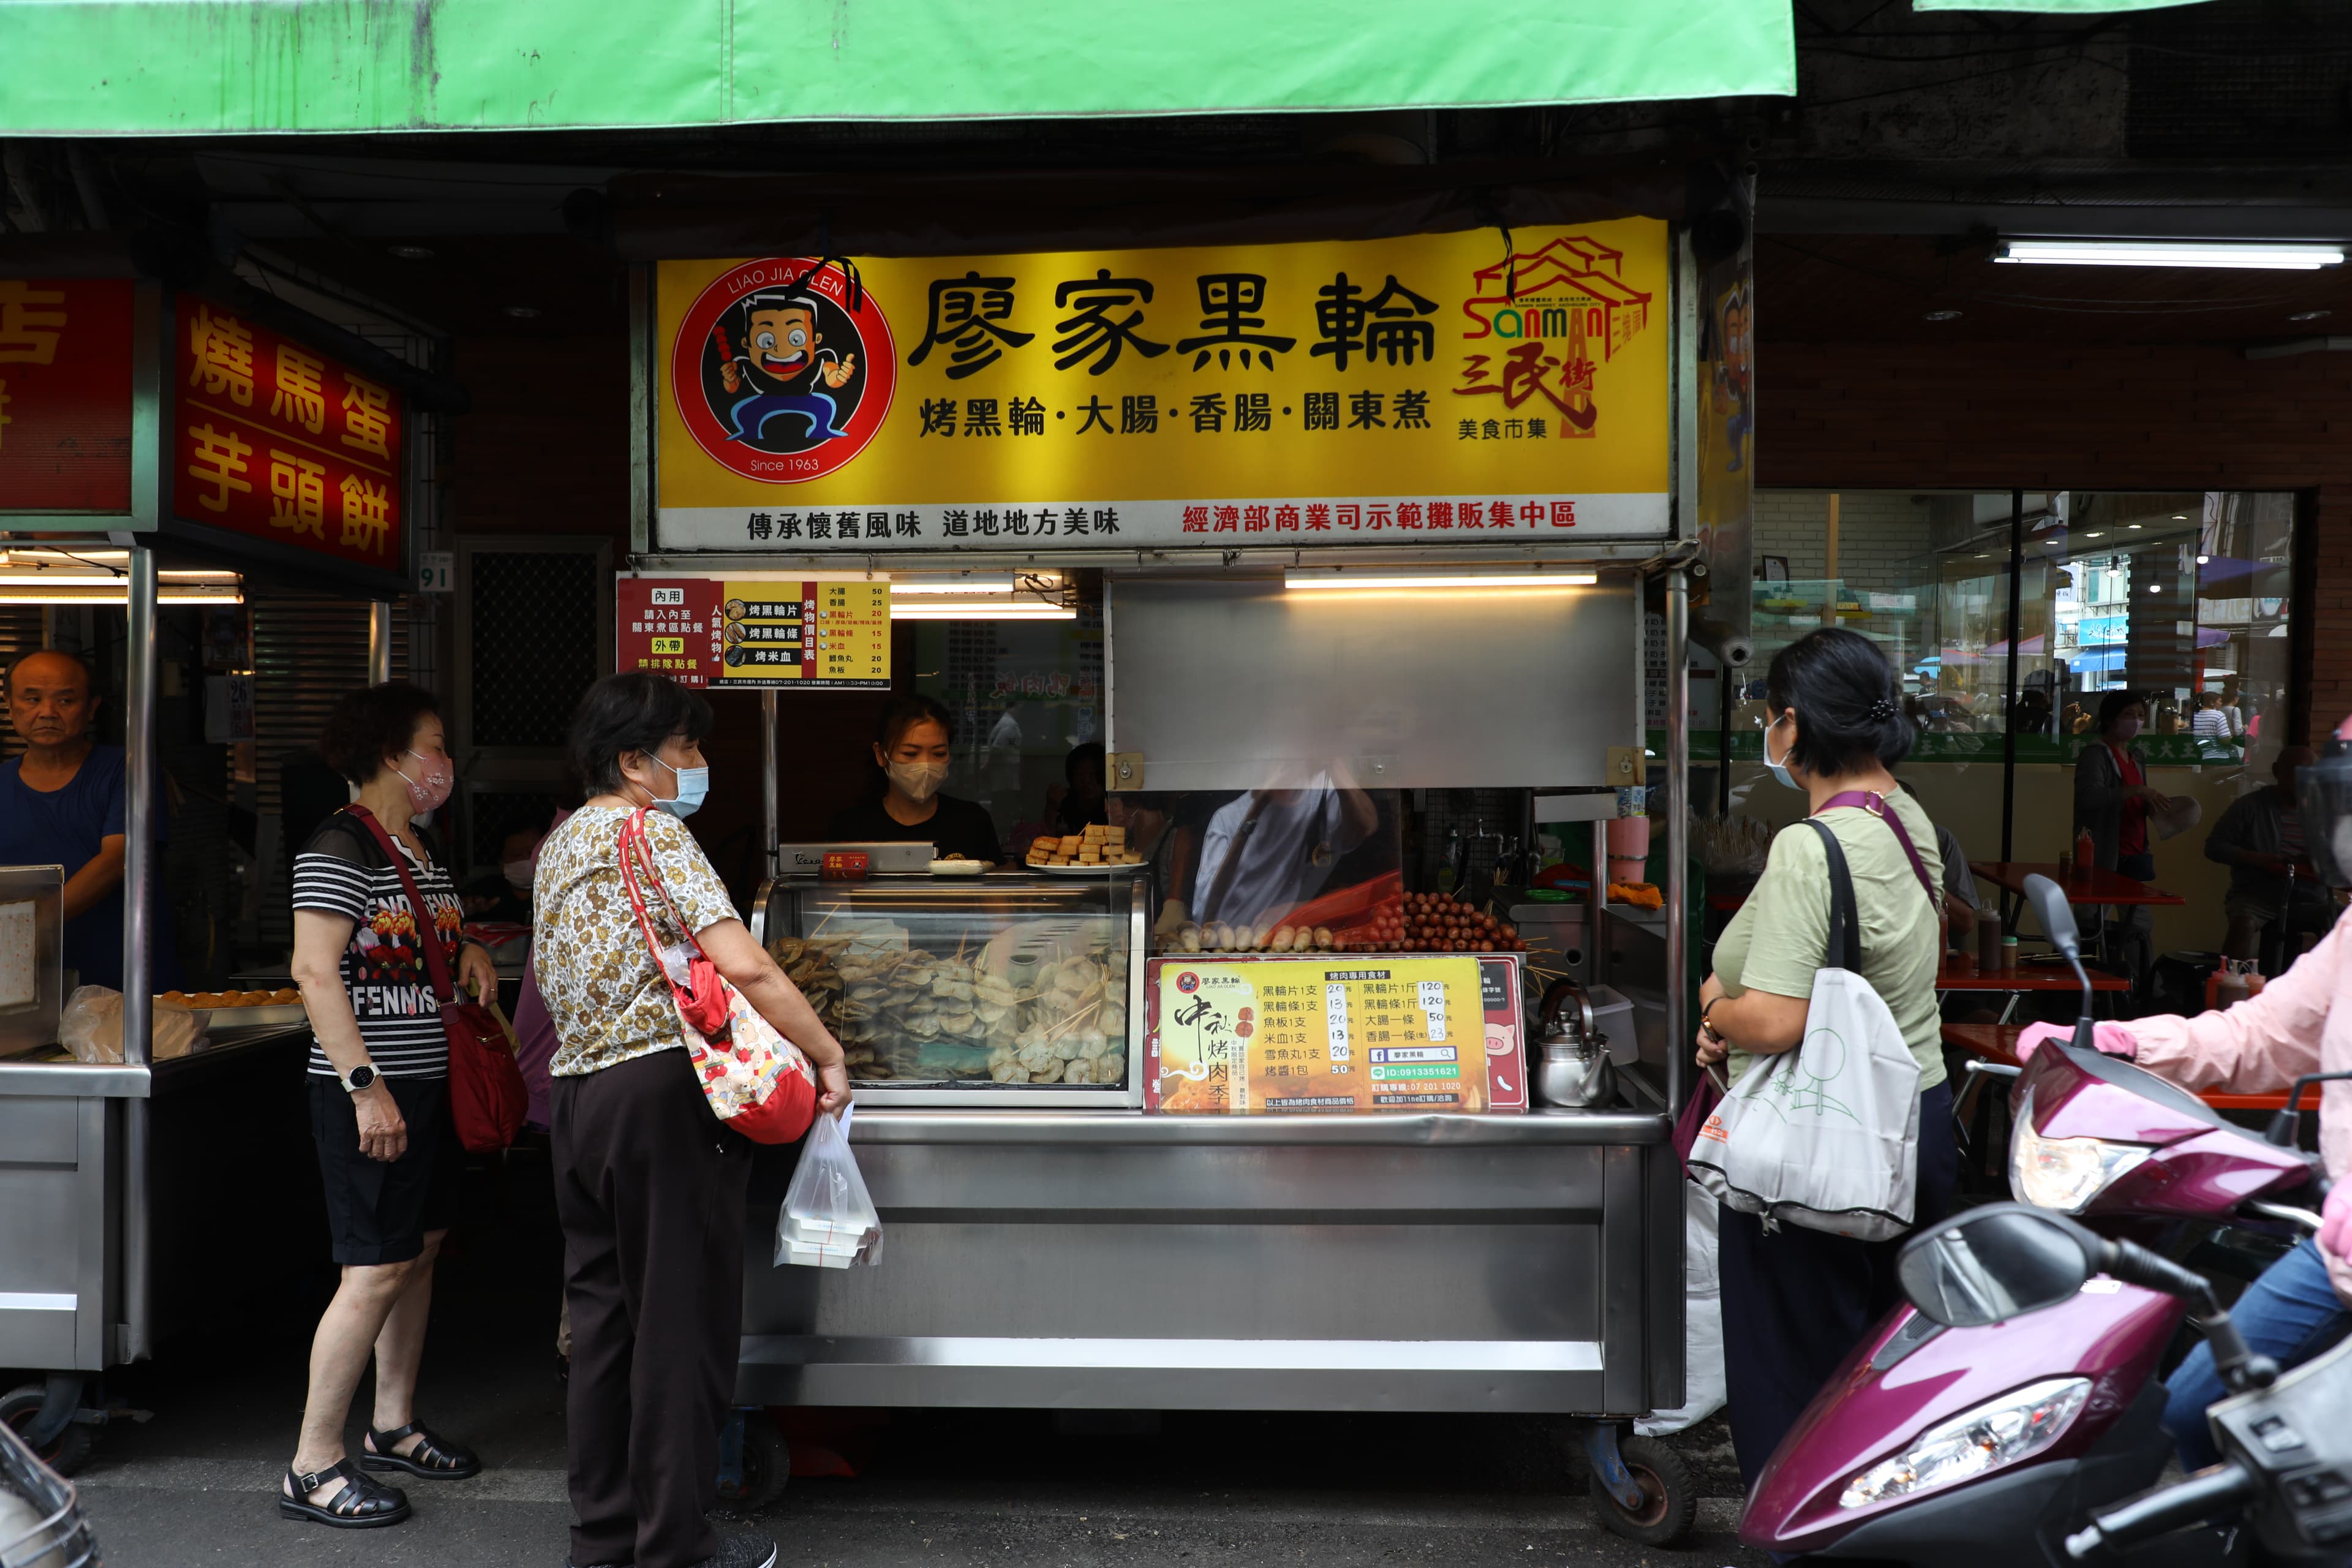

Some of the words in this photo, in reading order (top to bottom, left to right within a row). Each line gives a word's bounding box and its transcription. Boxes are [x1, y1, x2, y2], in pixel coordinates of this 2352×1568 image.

[727, 270, 765, 294] LIAO
[771, 268, 794, 281] JIA
[907, 268, 1440, 381] 廖家黑輪
[189, 304, 392, 462] 燒馬蛋
[1458, 417, 1547, 440] 美食市集
[750, 460, 784, 471] Since
[789, 459, 819, 471] 1963
[187, 423, 390, 556] 芋頭餅
[1182, 500, 1577, 533] 經濟部商業司示範攤販集中區
[747, 511, 922, 540] 傳承懷舊風味
[942, 507, 1120, 537] 道地地方美味
[421, 568, 445, 588] 91
[655, 590, 680, 603] 內用
[829, 598, 846, 607] 香腸
[644, 609, 692, 620] 請入內至
[749, 605, 797, 617] 烤黑輪片
[632, 622, 703, 633] 關東煮區點餐
[711, 605, 722, 654] 人氣烤物
[749, 628, 798, 639] 烤黑輪條
[804, 599, 816, 661] 烤物價目表
[829, 629, 854, 638] 黑輪條
[655, 639, 680, 652] 外帶
[755, 650, 791, 662] 烤米血
[638, 658, 698, 670] 請排隊點餐
[829, 666, 845, 674] 魚板
[1330, 971, 1386, 981] 烤肉專用食材
[1263, 986, 1317, 997] 黑輪片1支
[1363, 982, 1417, 995] 黑輪片1斤
[1422, 982, 1441, 991] 120
[1264, 1001, 1318, 1012] 黑輪條1支
[1330, 999, 1343, 1009] 13
[1364, 998, 1418, 1011] 黑輪條1斤
[1422, 997, 1443, 1006] 120
[1264, 1017, 1306, 1028] 魚板1支
[1365, 1014, 1415, 1026] 大腸一條
[1429, 1012, 1444, 1022] 50
[1264, 1032, 1307, 1044] 米血1支
[1430, 1027, 1445, 1039] 23
[1265, 1048, 1321, 1060] 雪魚丸1支
[1332, 1046, 1348, 1057] 20
[1207, 1039, 1230, 1105] 烤肉季
[1264, 1065, 1308, 1077] 烤醬1包
[1331, 1064, 1349, 1074] 50
[1387, 1067, 1457, 1077] ID:0913351621
[1441, 1082, 1461, 1090] 1020
[1266, 1097, 1355, 1107] 以上皆為烤肉食材商品價格
